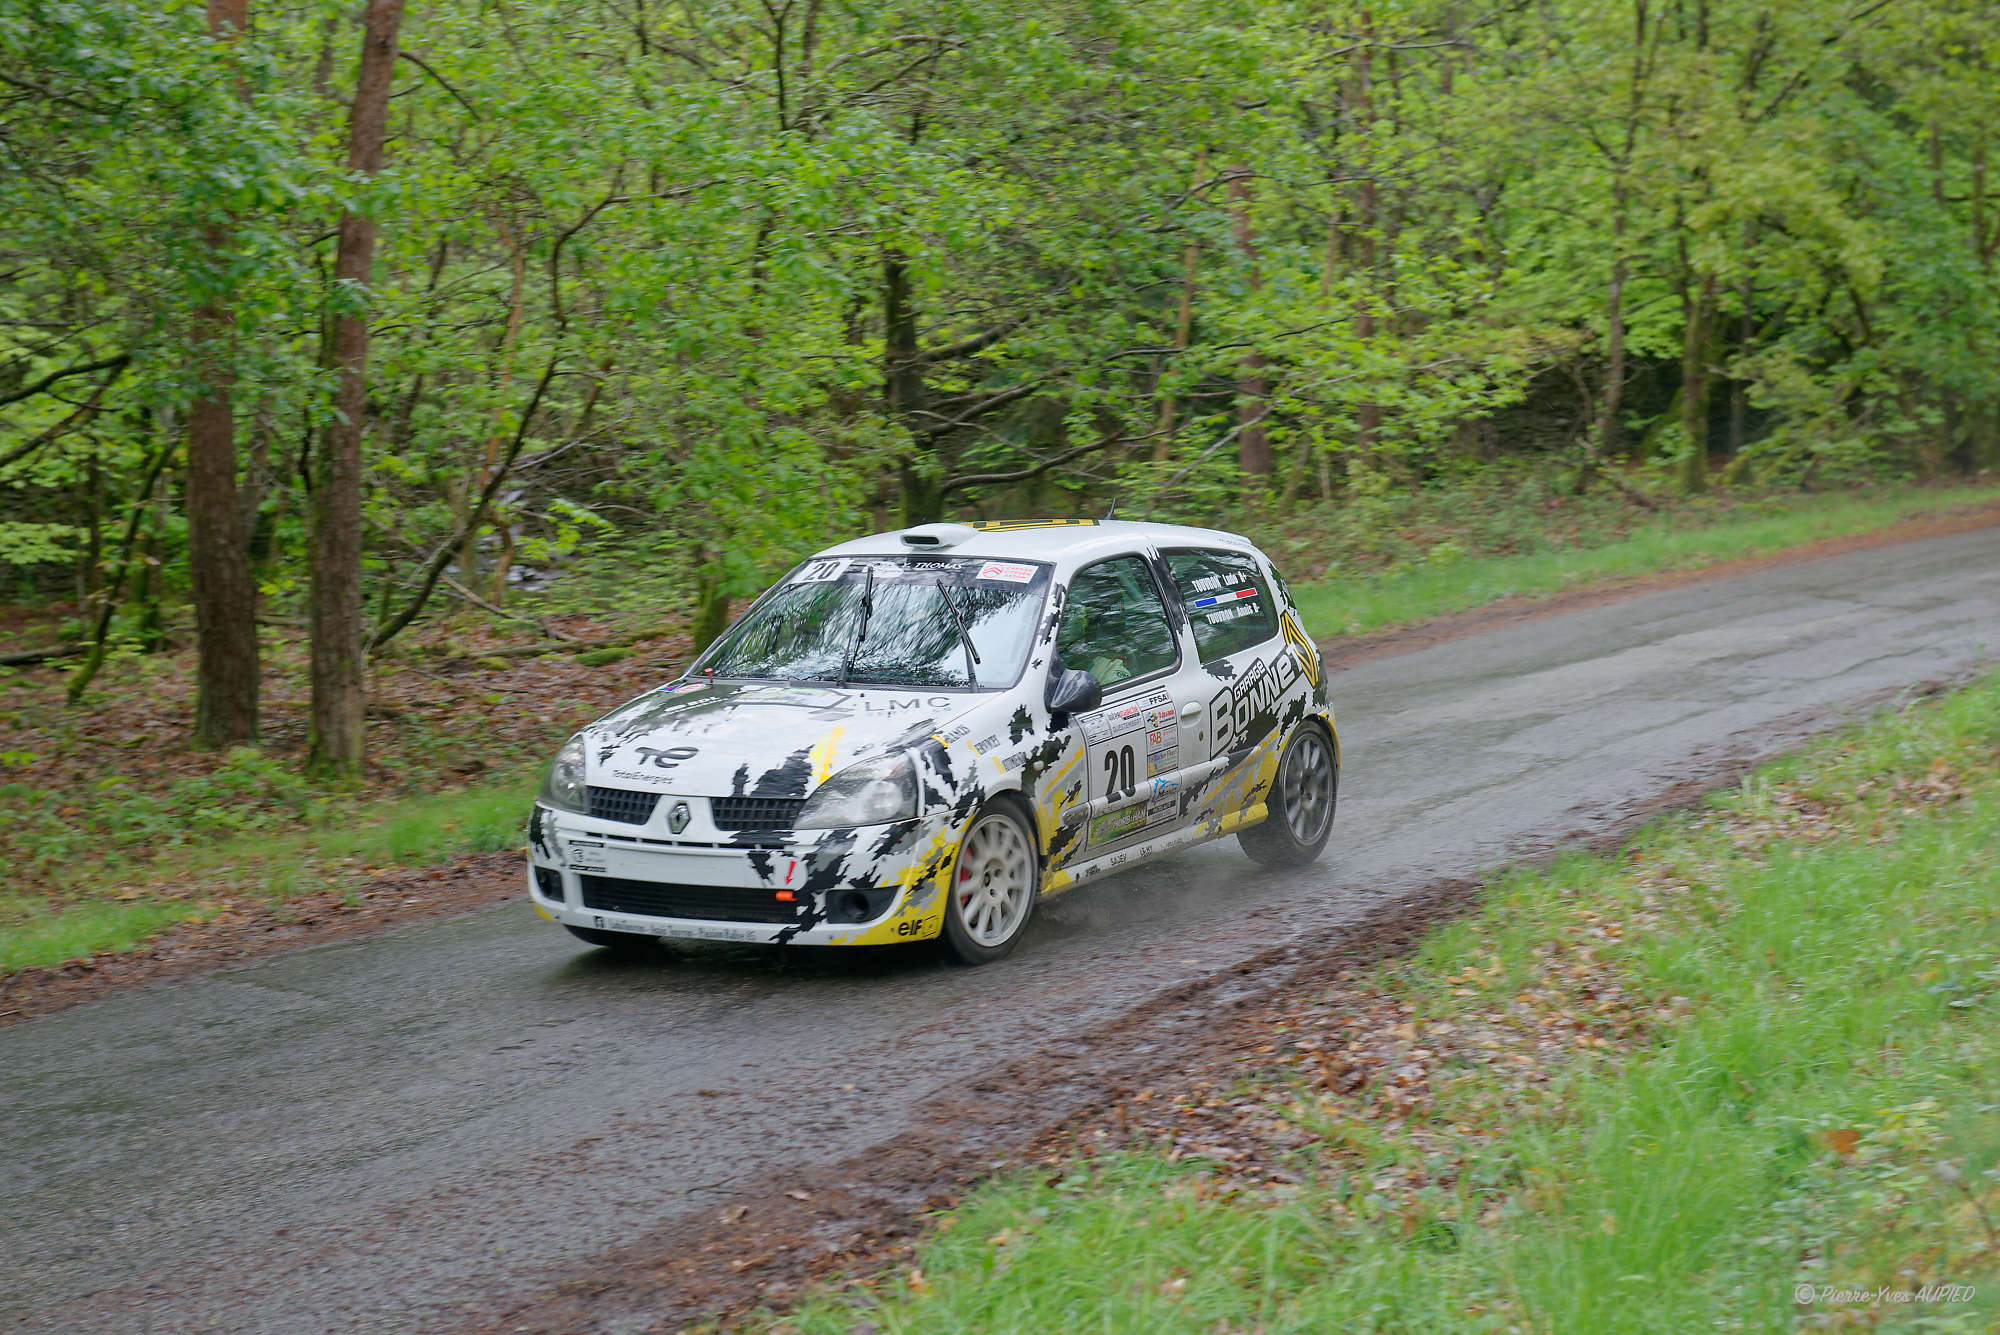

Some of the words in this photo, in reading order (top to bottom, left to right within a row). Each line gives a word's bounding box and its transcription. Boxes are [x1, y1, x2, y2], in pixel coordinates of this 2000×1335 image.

[808, 561, 841, 580] 20
[913, 561, 963, 570] THOMAS
[865, 696, 951, 712] LMC
[1149, 694, 1168, 705] FFSA
[1104, 744, 1136, 804] 20
[898, 919, 923, 936] elf
